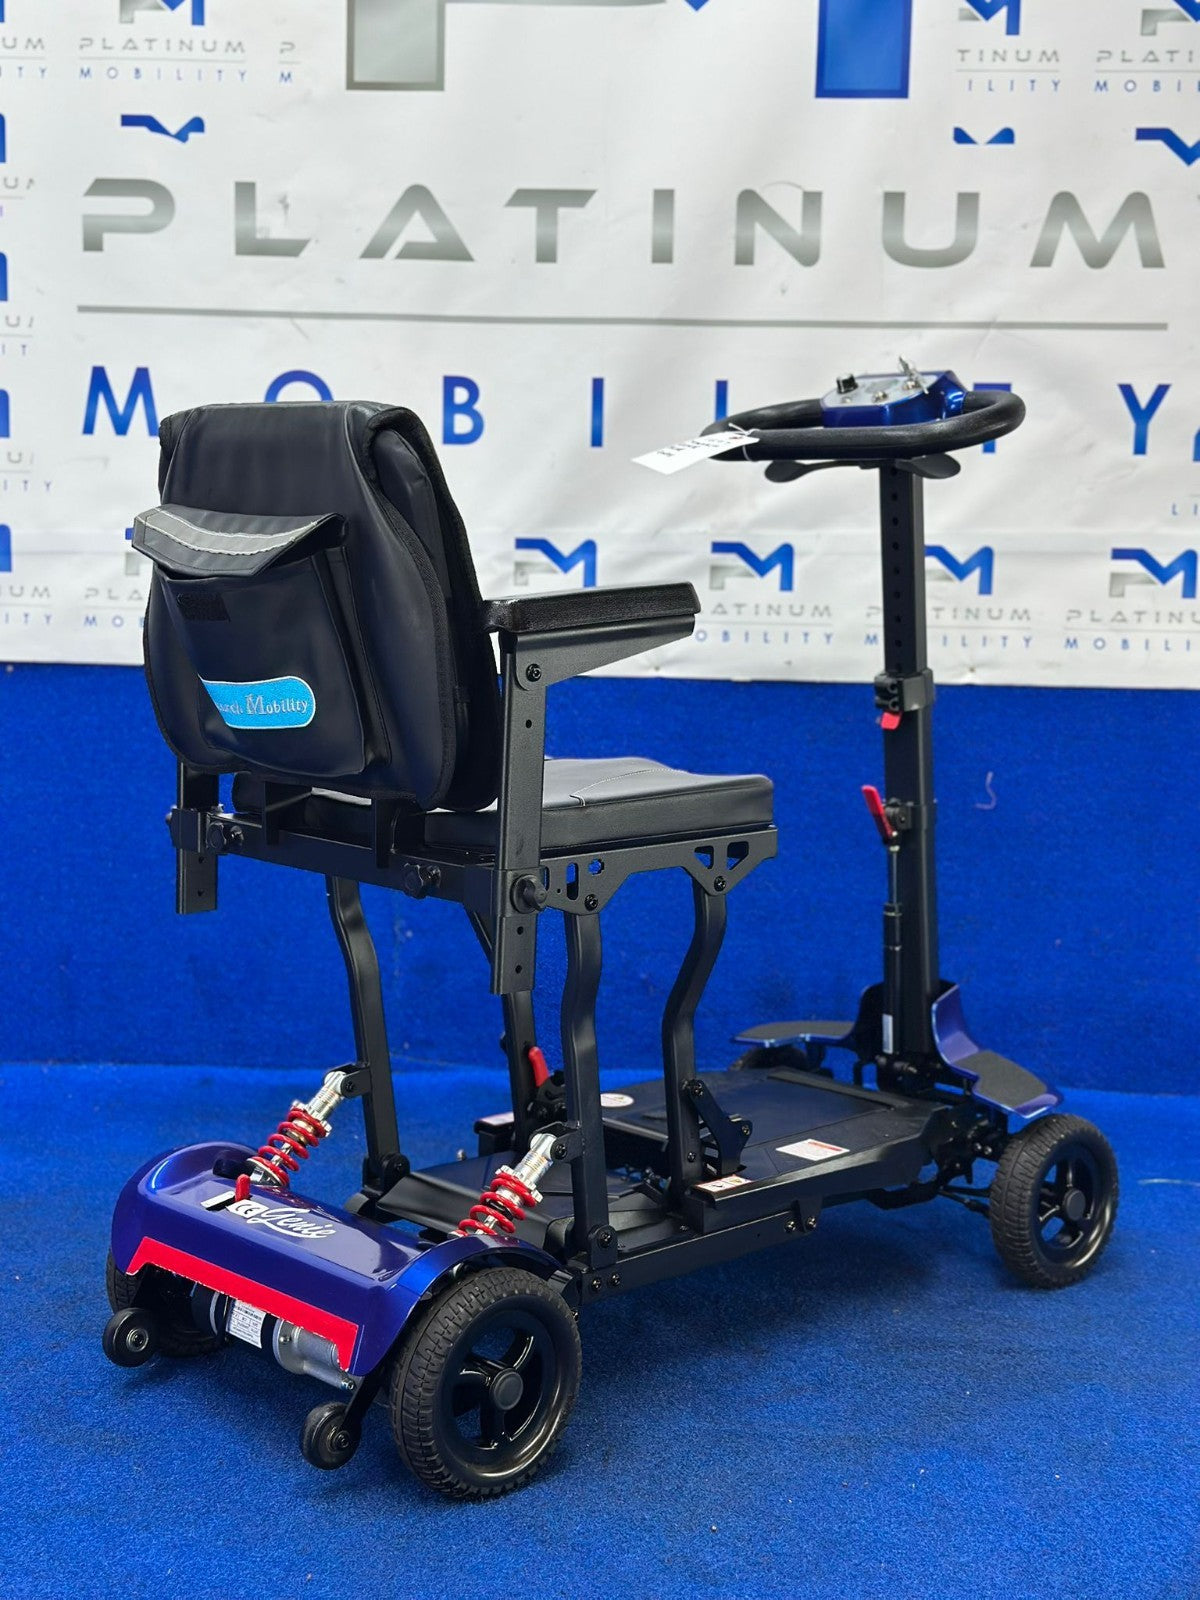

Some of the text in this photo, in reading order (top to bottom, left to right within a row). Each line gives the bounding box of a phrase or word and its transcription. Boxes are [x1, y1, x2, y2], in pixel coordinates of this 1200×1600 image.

[79, 37, 245, 53] PLATINUM
[79, 66, 247, 81] MOBILITY
[82, 177, 1166, 270] PLATINUM
[82, 365, 1173, 456] MBIY
[700, 602, 832, 617] ATINUM
[866, 605, 1032, 620] PTINUM
[865, 633, 1033, 648] MILITY
[245, 694, 308, 715] Mobility
